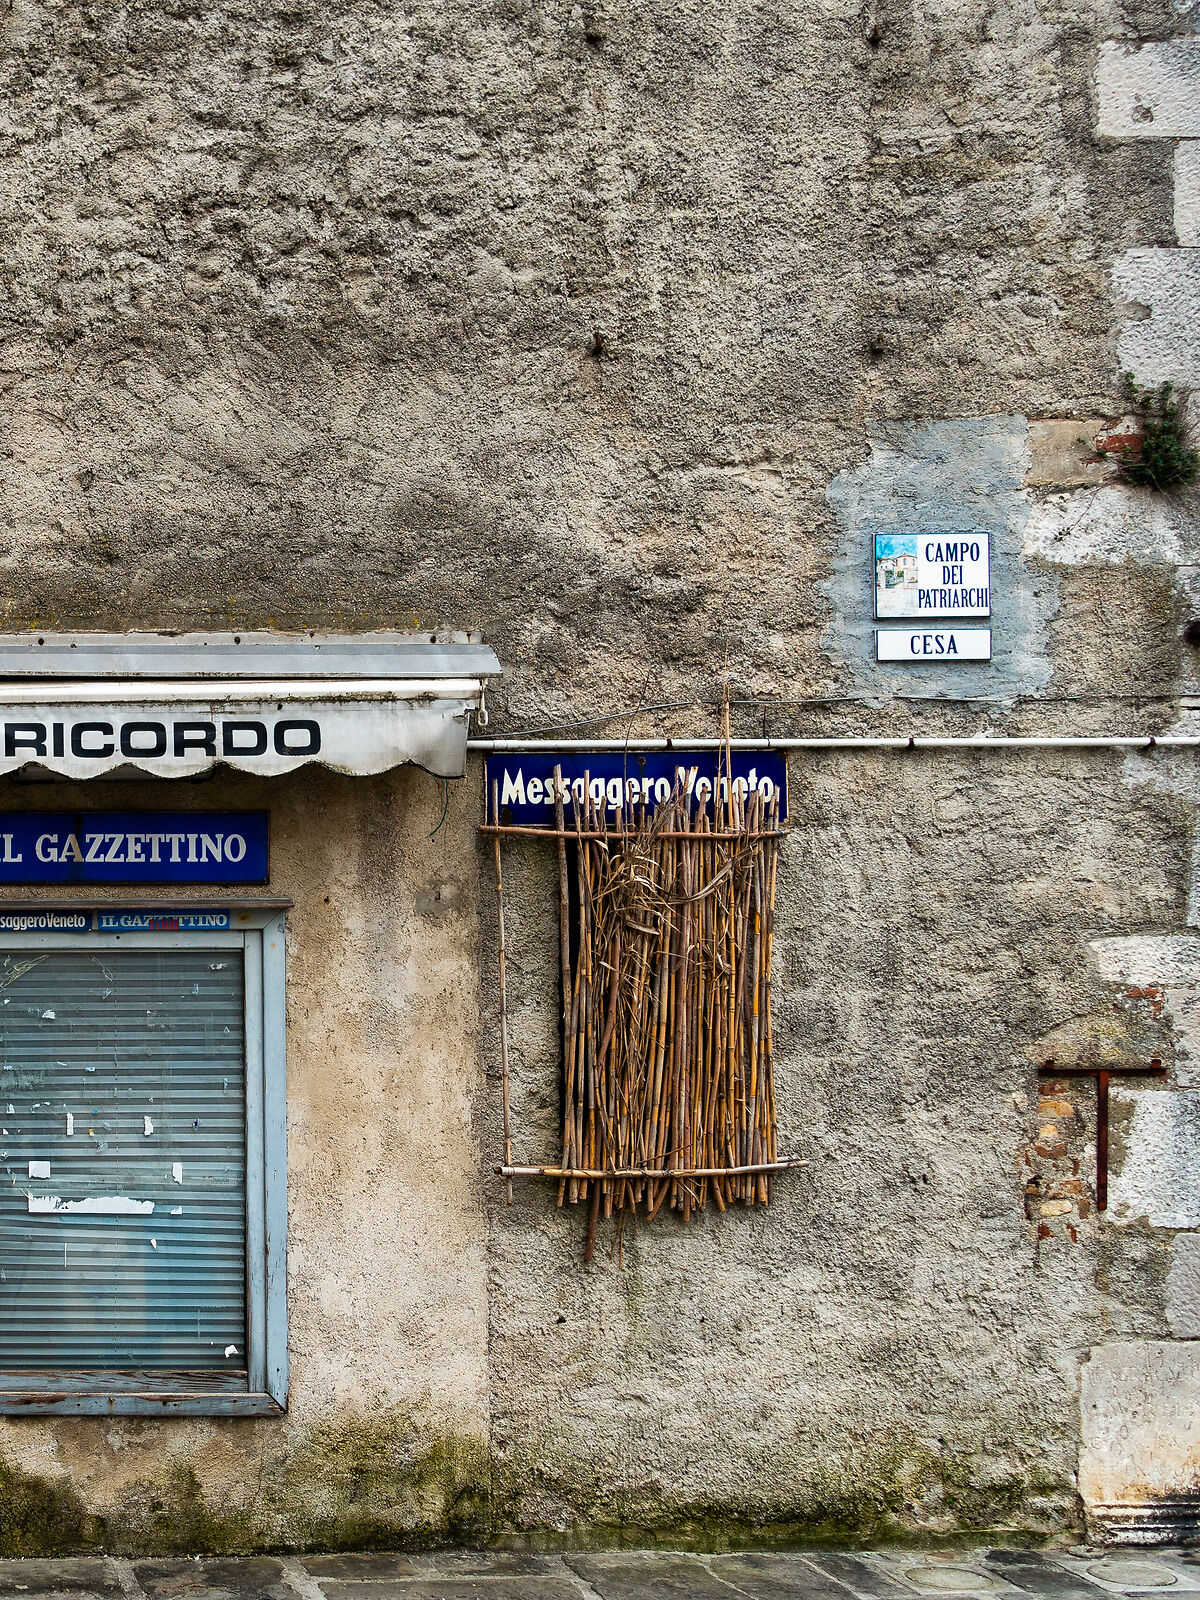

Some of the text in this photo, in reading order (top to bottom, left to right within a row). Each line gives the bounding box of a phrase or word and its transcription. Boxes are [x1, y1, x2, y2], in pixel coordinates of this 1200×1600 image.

[925, 542, 980, 562] CAMPO
[942, 565, 963, 585] DEI
[918, 588, 989, 608] PATRIARCHI
[910, 634, 958, 655] CESA
[4, 719, 322, 758] RICORDO
[501, 766, 774, 810] Messaggero Veneto
[35, 832, 247, 863] GAZZETTINO
[101, 915, 119, 927] IL
